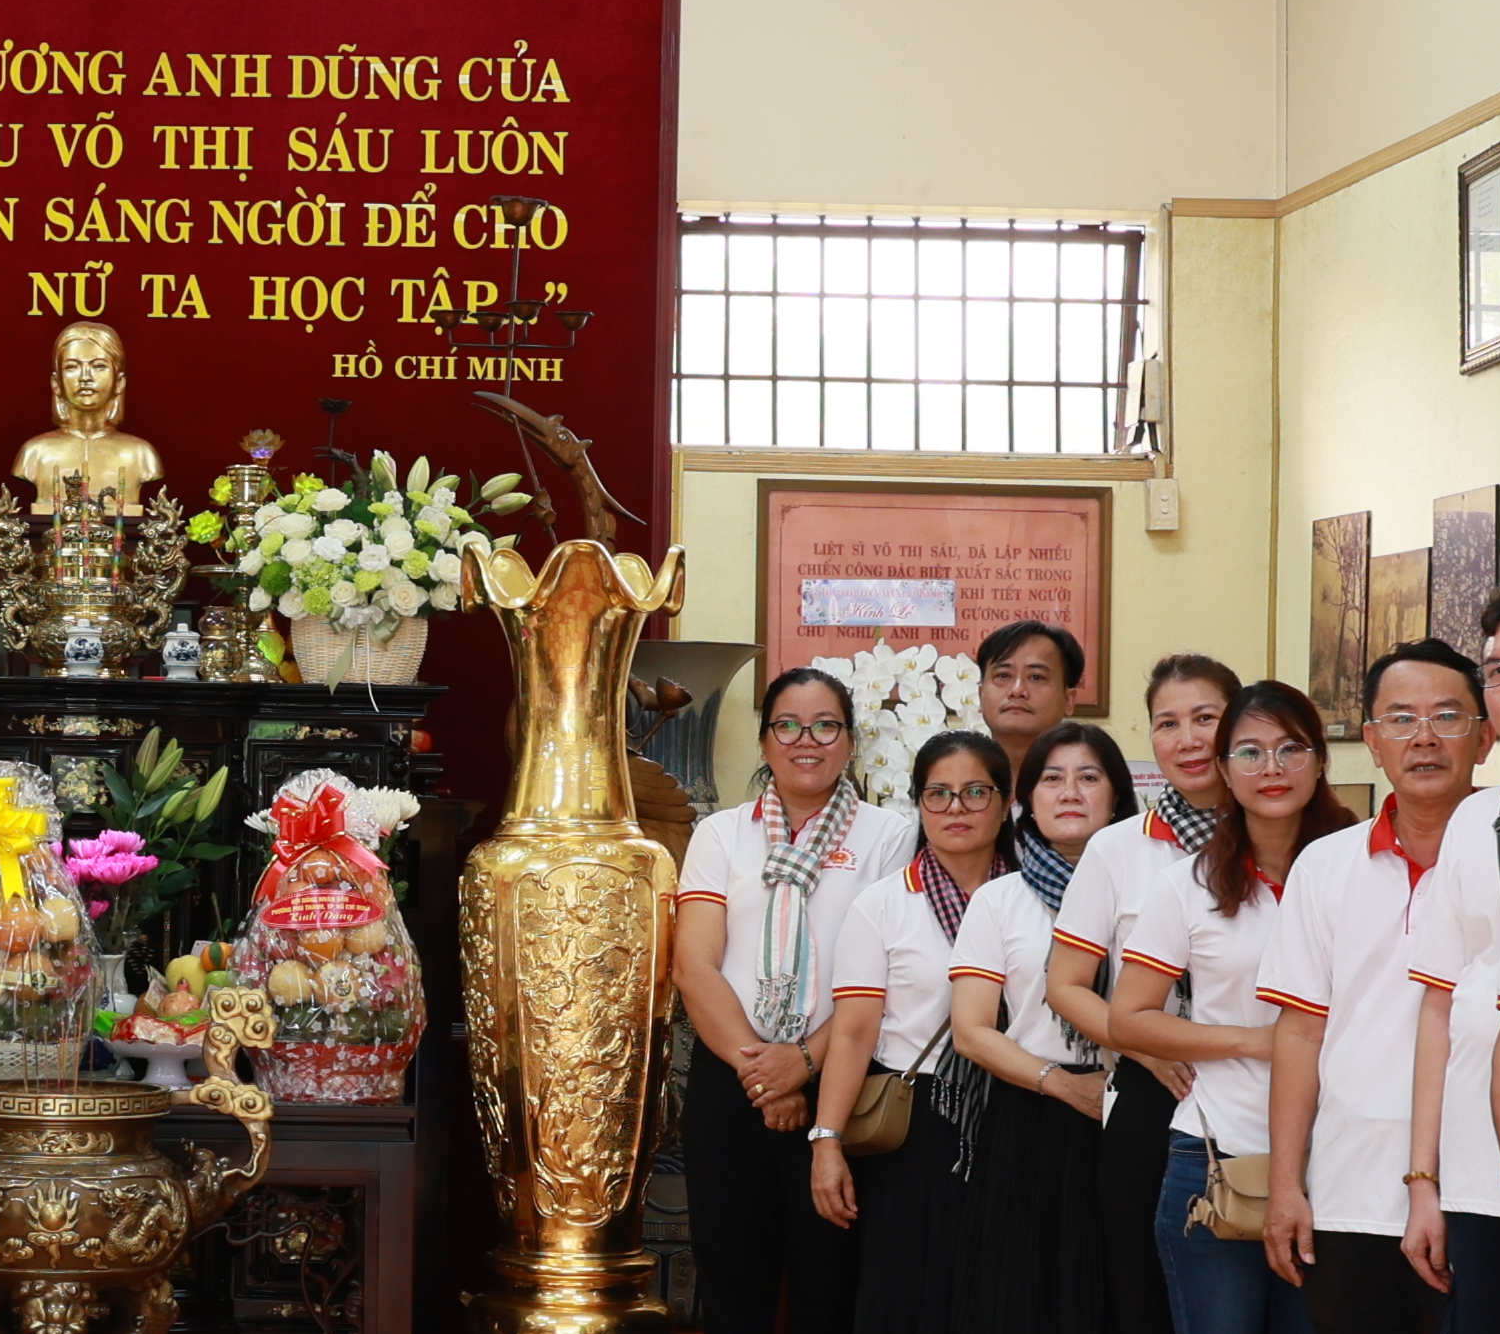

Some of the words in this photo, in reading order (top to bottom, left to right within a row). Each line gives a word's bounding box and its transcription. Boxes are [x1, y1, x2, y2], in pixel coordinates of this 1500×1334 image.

[142, 52, 272, 98] ANH
[287, 43, 443, 101] DŨNG
[458, 39, 571, 103] CỦA
[46, 111, 123, 169] VÕ
[153, 125, 254, 182] THỊ
[287, 113, 394, 173] SÁU
[420, 116, 569, 175] LUÔN
[44, 183, 194, 244] SÁNG
[207, 186, 346, 247] NGỜI
[362, 182, 437, 248] ĐỂ
[453, 203, 569, 251] CHO
[27, 259, 114, 317] NỮ
[140, 274, 211, 319] TA
[248, 275, 365, 333] HỌC
[331, 339, 383, 379] HỒ
[394, 346, 459, 380] CHÍ
[466, 356, 564, 382] MINH
[813, 540, 845, 556] LIỆT
[873, 542, 892, 557] VÕ
[899, 545, 923, 560] THỊ
[930, 543, 960, 560] SÁU,
[968, 544, 987, 559] ĐÃ
[995, 544, 1022, 563] LẬP
[845, 562, 883, 577] CÔNG
[955, 562, 991, 579] XUẤT
[996, 563, 1022, 580] SẮC
[1026, 568, 1072, 581] TRONG
[960, 585, 985, 600] KHÍ
[991, 584, 1022, 601] TIẾT
[1028, 586, 1071, 602] NGƯỜI
[961, 608, 1010, 621] GƯƠNG
[891, 628, 920, 640] ANH
